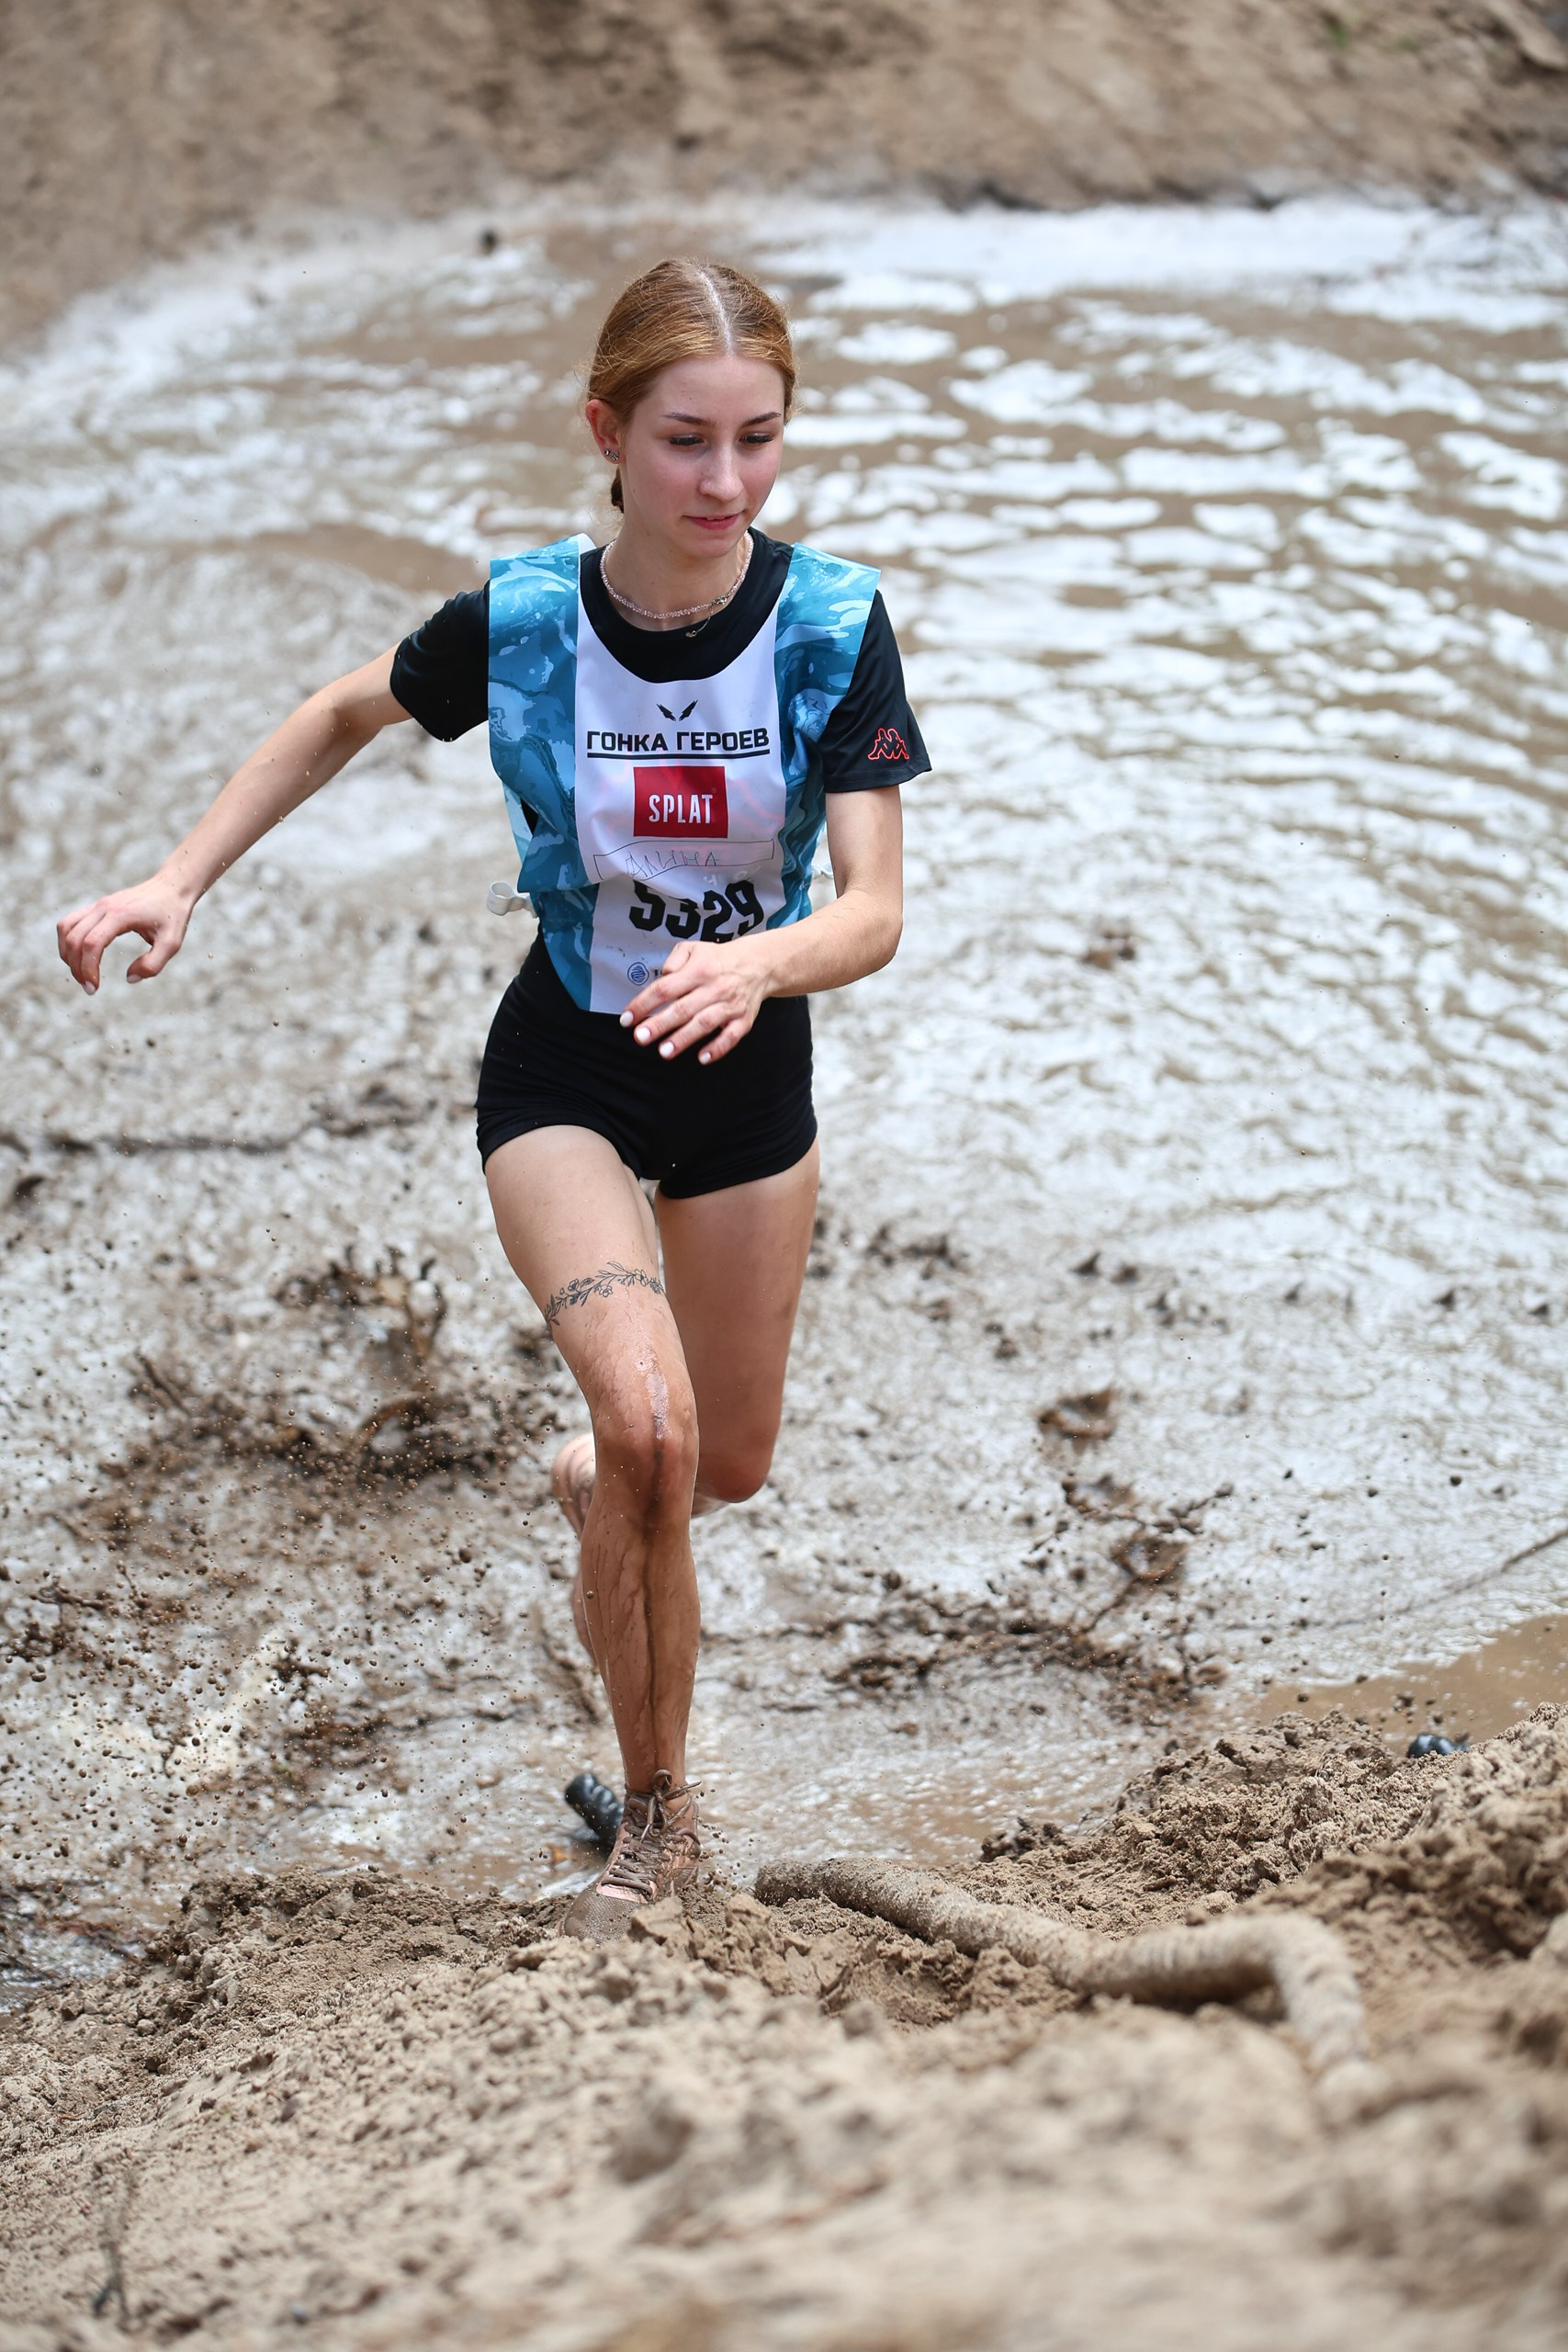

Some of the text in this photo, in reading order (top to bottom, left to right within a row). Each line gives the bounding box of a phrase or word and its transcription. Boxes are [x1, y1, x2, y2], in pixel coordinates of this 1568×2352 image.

[587, 727, 770, 752] ГОНКА ГЕРОЕВ
[649, 794, 714, 824] SPLAT
[629, 879, 764, 944] 5329
